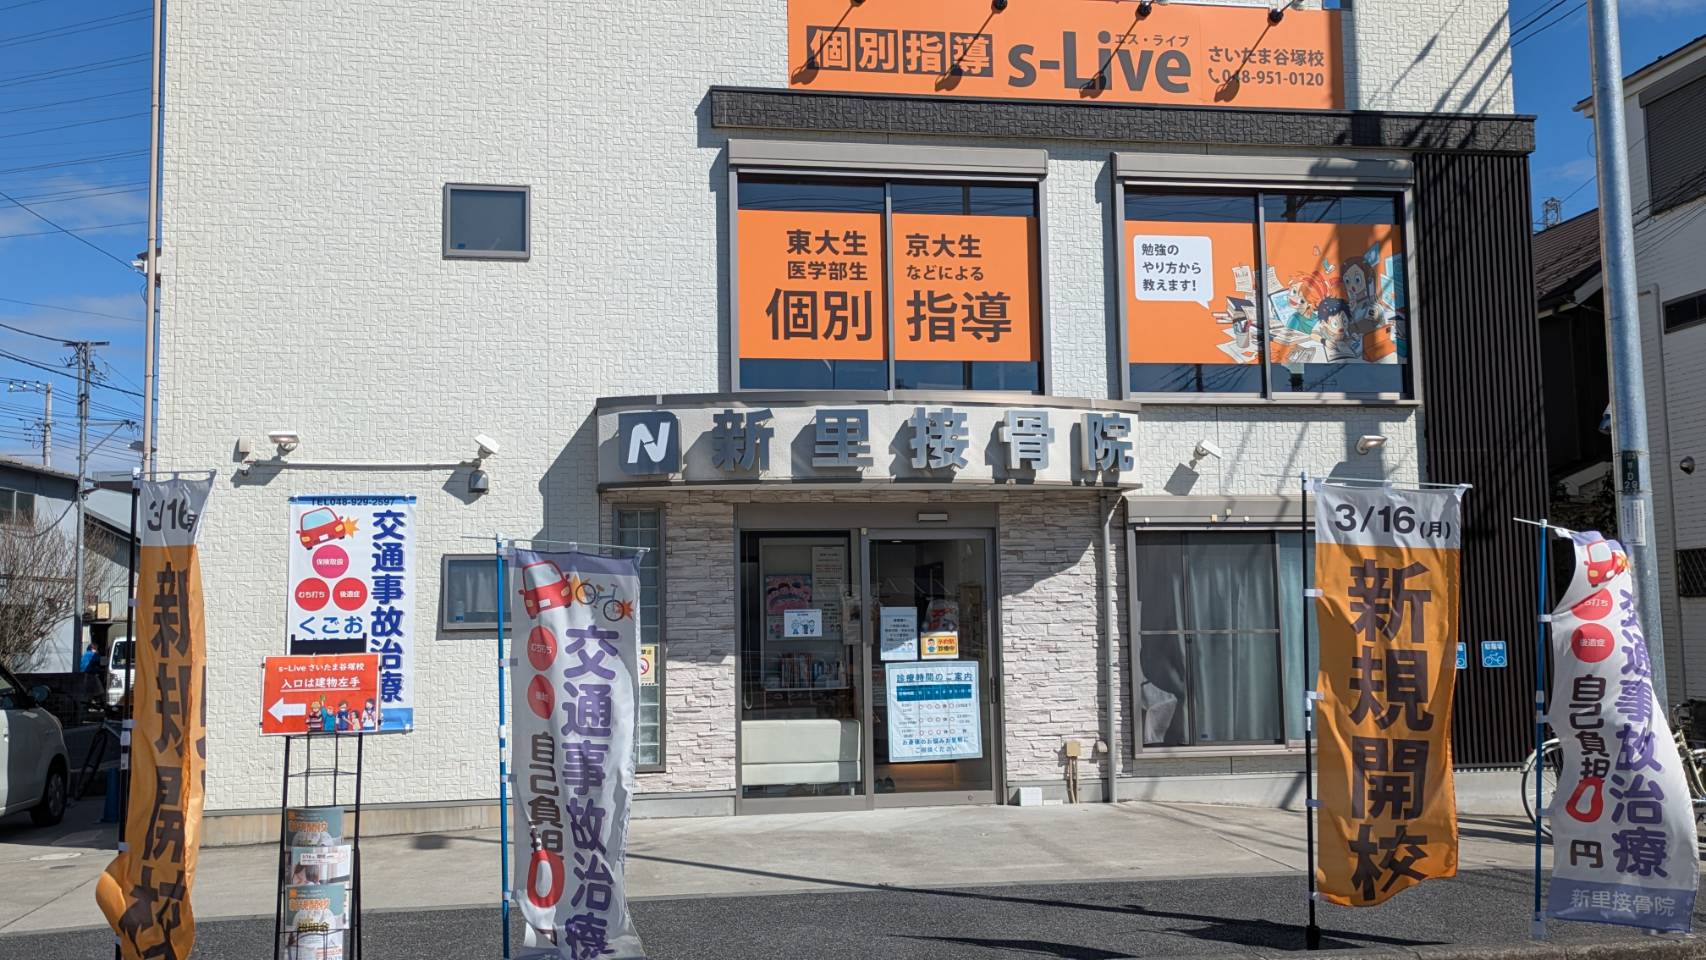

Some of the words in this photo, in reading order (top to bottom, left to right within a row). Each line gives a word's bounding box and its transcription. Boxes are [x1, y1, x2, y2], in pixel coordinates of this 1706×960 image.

[1115, 33, 1190, 47] エス・ライブ
[807, 26, 993, 77] 個別指導
[1007, 31, 1192, 93] s-Live
[1208, 45, 1325, 68] さいたま谷塚校
[786, 228, 868, 257] 東大生
[905, 233, 982, 258] 京大生
[1141, 243, 1179, 256] 勉強の
[787, 260, 868, 281] 医学部生
[906, 264, 984, 281] などによる
[1141, 261, 1202, 275] やり方から
[765, 288, 872, 341] 個別
[906, 290, 1012, 343] 指導
[711, 407, 1133, 472] 新里接骨院
[371, 509, 407, 702] 交通事故治療
[1583, 599, 1608, 607] ち打ち
[278, 664, 306, 672] s-Live
[308, 662, 365, 672] さいたま谷塚校
[896, 672, 973, 683] 診療時間のご案内
[281, 676, 361, 689] 入口は建物左手
[1347, 559, 1434, 900] 新規開校
[561, 625, 619, 960] 交通事故治療
[1570, 888, 1676, 917] 新里接骨院
